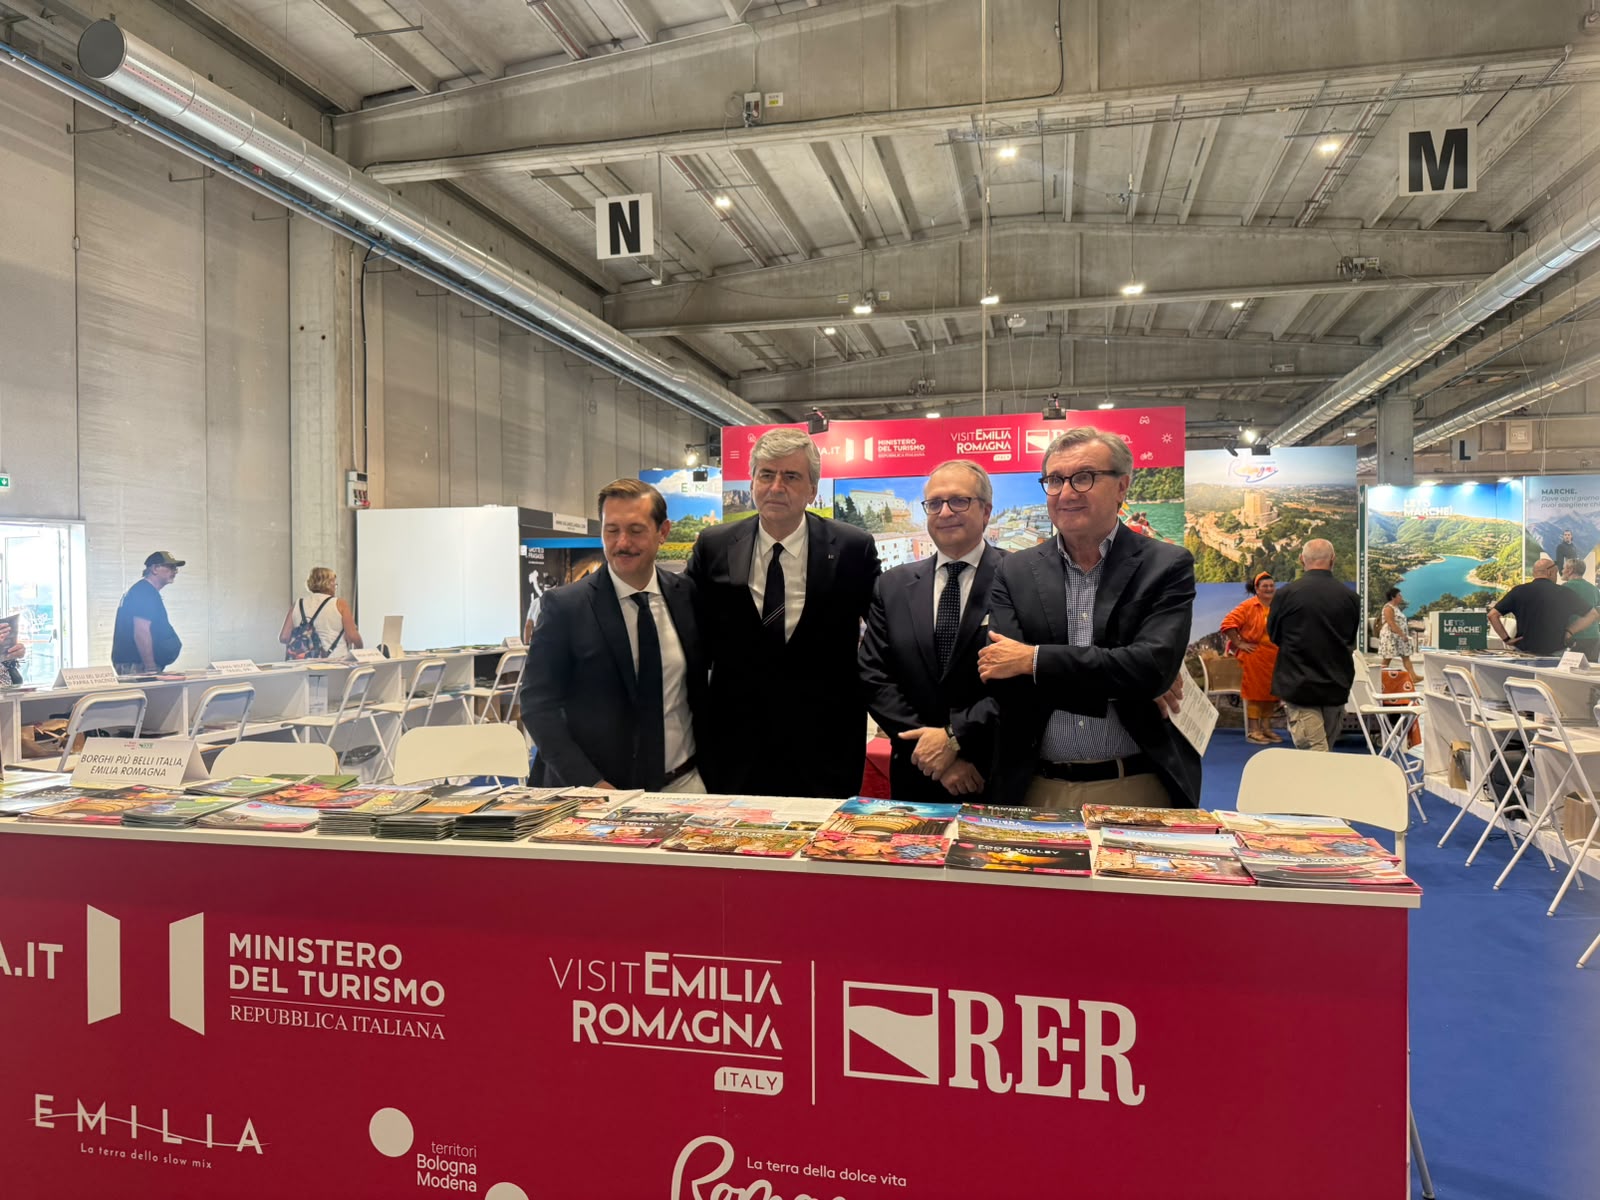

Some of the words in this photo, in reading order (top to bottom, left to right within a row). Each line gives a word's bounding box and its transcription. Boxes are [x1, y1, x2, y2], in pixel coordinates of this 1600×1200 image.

[1409, 128, 1468, 192] M
[609, 200, 640, 255] N
[956, 441, 1012, 454] ROMAGNA
[1459, 440, 1471, 460] L
[81, 754, 115, 763] BORGHI
[115, 754, 131, 764] PIÙ
[132, 756, 154, 765] BELLI
[155, 757, 184, 767] ITALIA,
[90, 766, 118, 775] EMILIA
[120, 766, 166, 776] ROMAGNA
[229, 932, 402, 970] MINISTERO
[229, 964, 288, 994] DEL
[298, 970, 445, 1007] TURISMO
[230, 1004, 348, 1031] REPUBBLICA
[352, 1015, 445, 1040] ITALIANA
[573, 1000, 783, 1050] ROMAGNA
[723, 1071, 778, 1091] ITALY
[35, 1093, 263, 1154] EMILIA
[81, 1143, 94, 1153] La
[99, 1146, 126, 1158] terra
[130, 1149, 159, 1162] dello
[163, 1153, 187, 1166] slow
[192, 1159, 212, 1169] mix
[431, 1141, 477, 1158] territori
[417, 1153, 477, 1177] Bologna
[747, 1156, 762, 1170] La
[766, 1159, 799, 1174] terra
[803, 1163, 836, 1179] della
[839, 1169, 877, 1183] dolce
[880, 1173, 907, 1187] vita
[417, 1170, 477, 1193] Modena
